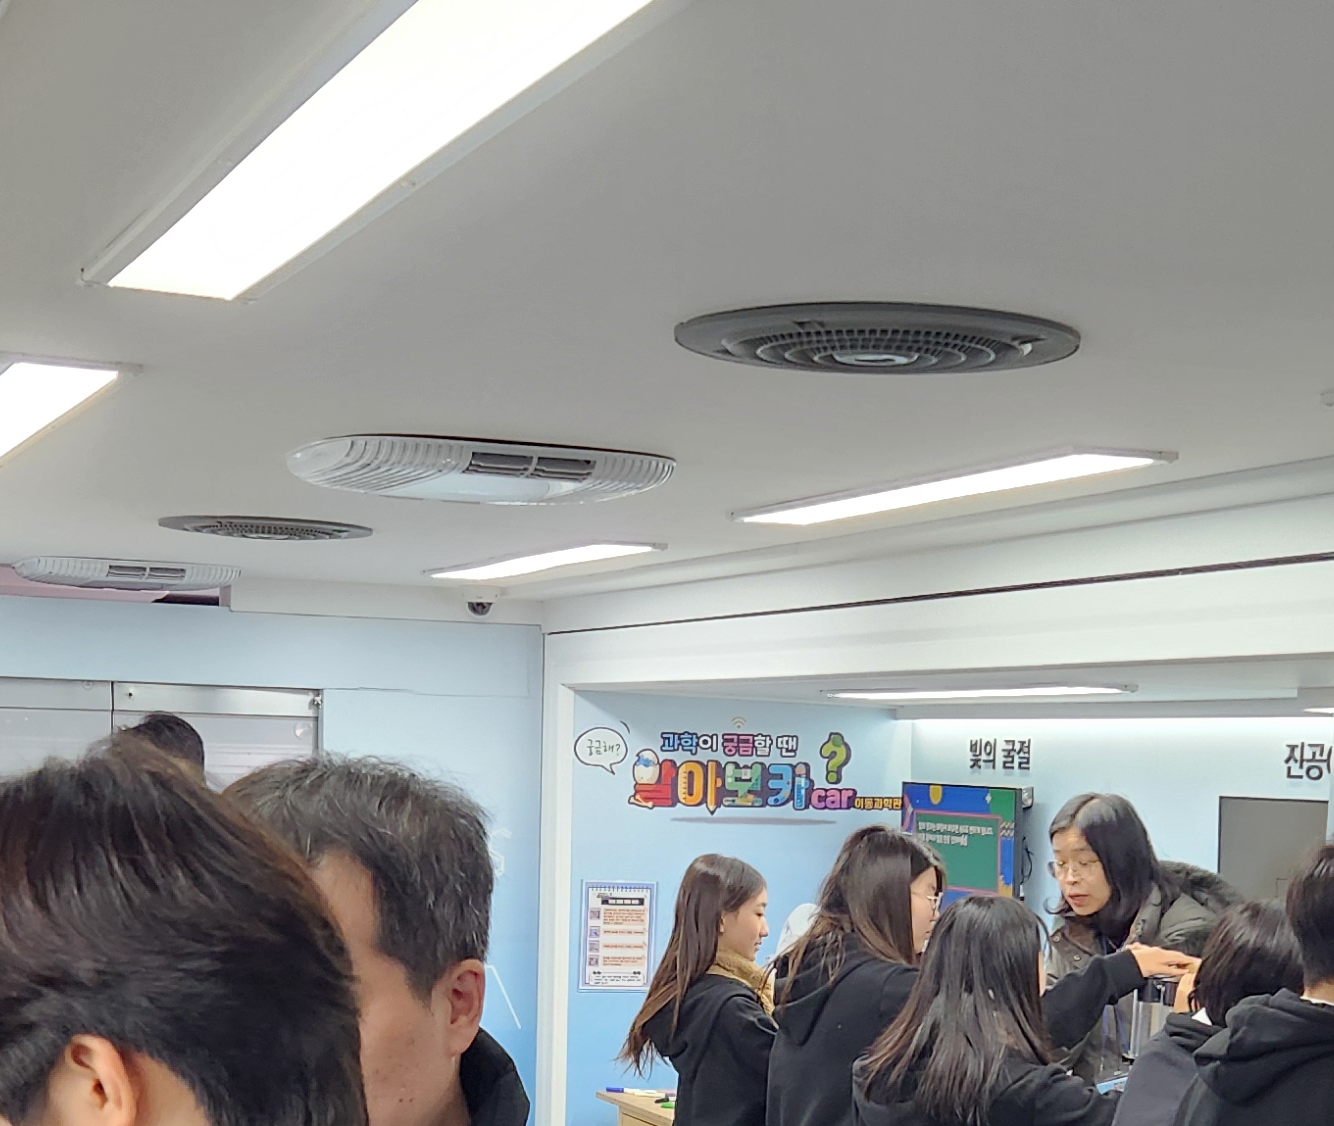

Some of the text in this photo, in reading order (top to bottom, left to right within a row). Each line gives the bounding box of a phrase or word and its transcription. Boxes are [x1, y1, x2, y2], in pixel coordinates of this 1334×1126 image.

[586, 738, 622, 757] 궁금해?
[661, 731, 799, 758] 과학이 궁금할 땐
[969, 738, 1031, 770] 빛의 굴절
[810, 788, 857, 810] car
[854, 796, 903, 811] 이동과학관
